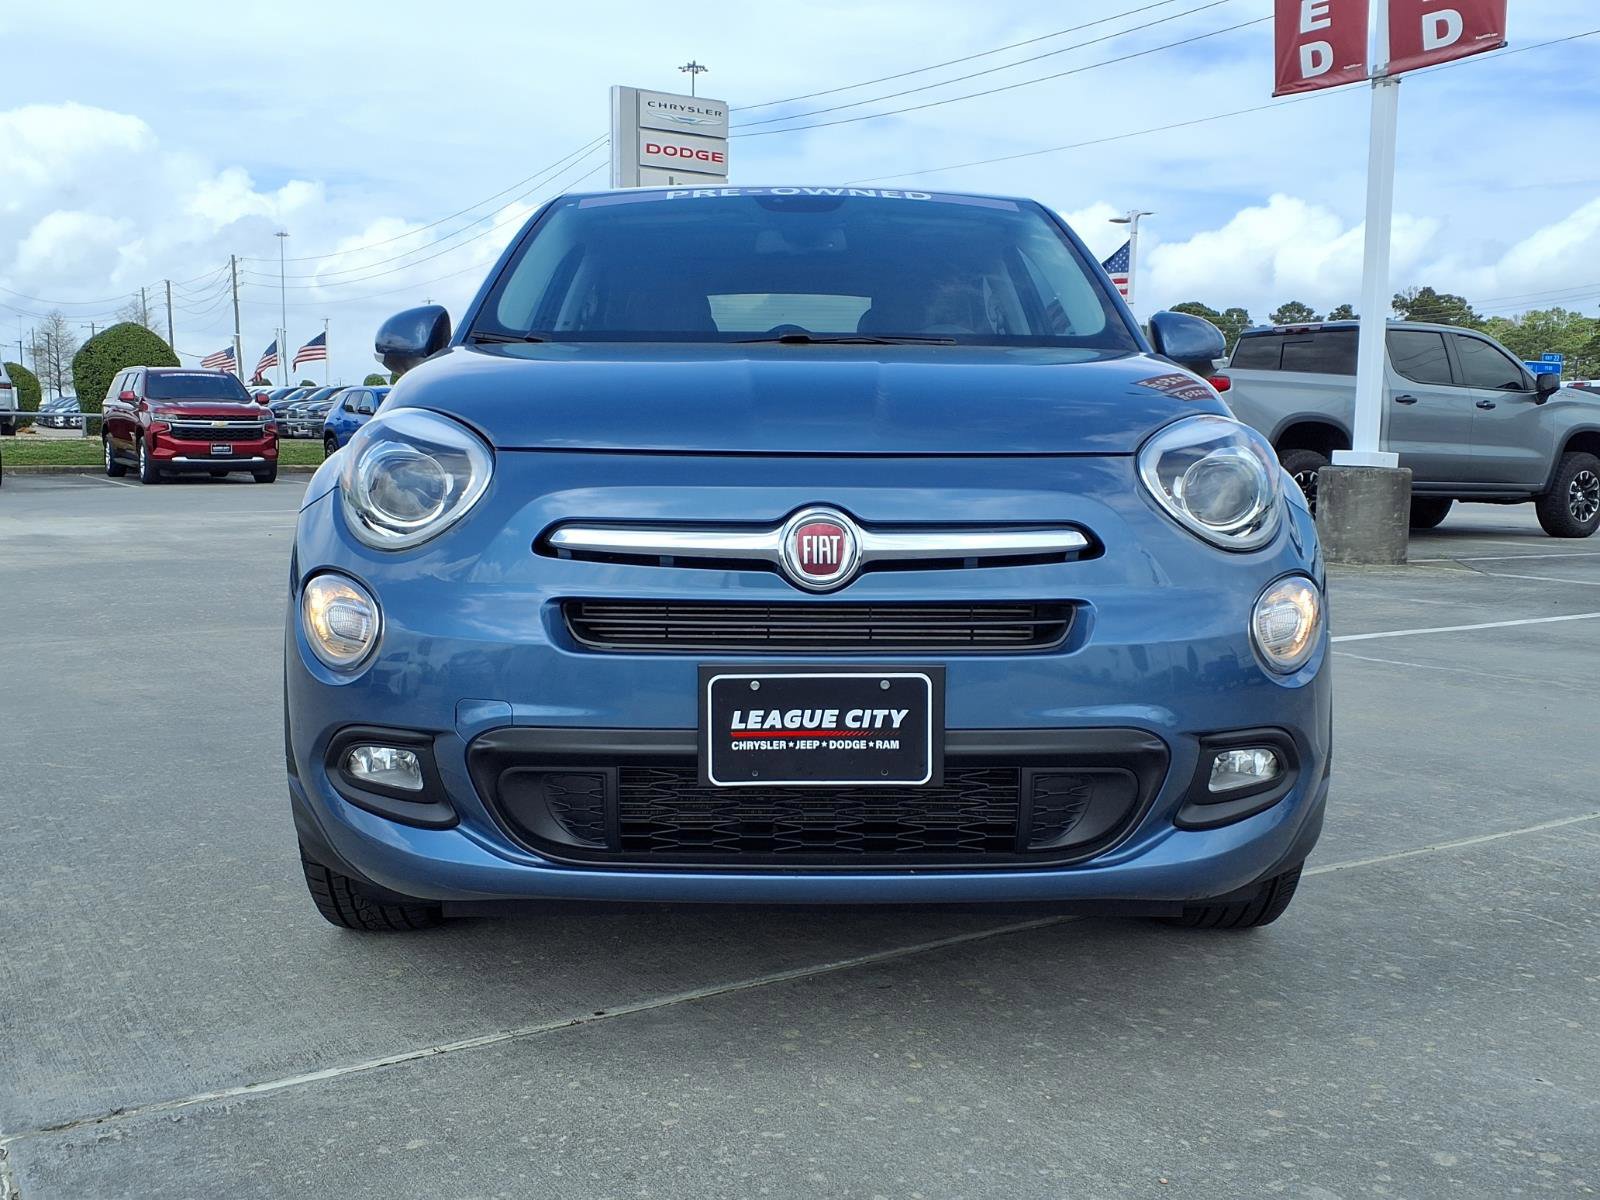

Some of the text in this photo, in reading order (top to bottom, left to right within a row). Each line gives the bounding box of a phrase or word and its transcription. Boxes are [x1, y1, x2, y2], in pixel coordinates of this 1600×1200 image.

[647, 101, 722, 117] CHRYSLER
[646, 143, 724, 163] DODGE
[666, 186, 932, 200] PRE-OWNED
[803, 535, 840, 565] FIAT
[730, 709, 909, 729] LEAGUE CITY
[731, 740, 900, 750] CHRYSLER JEEP DODGE RAM
